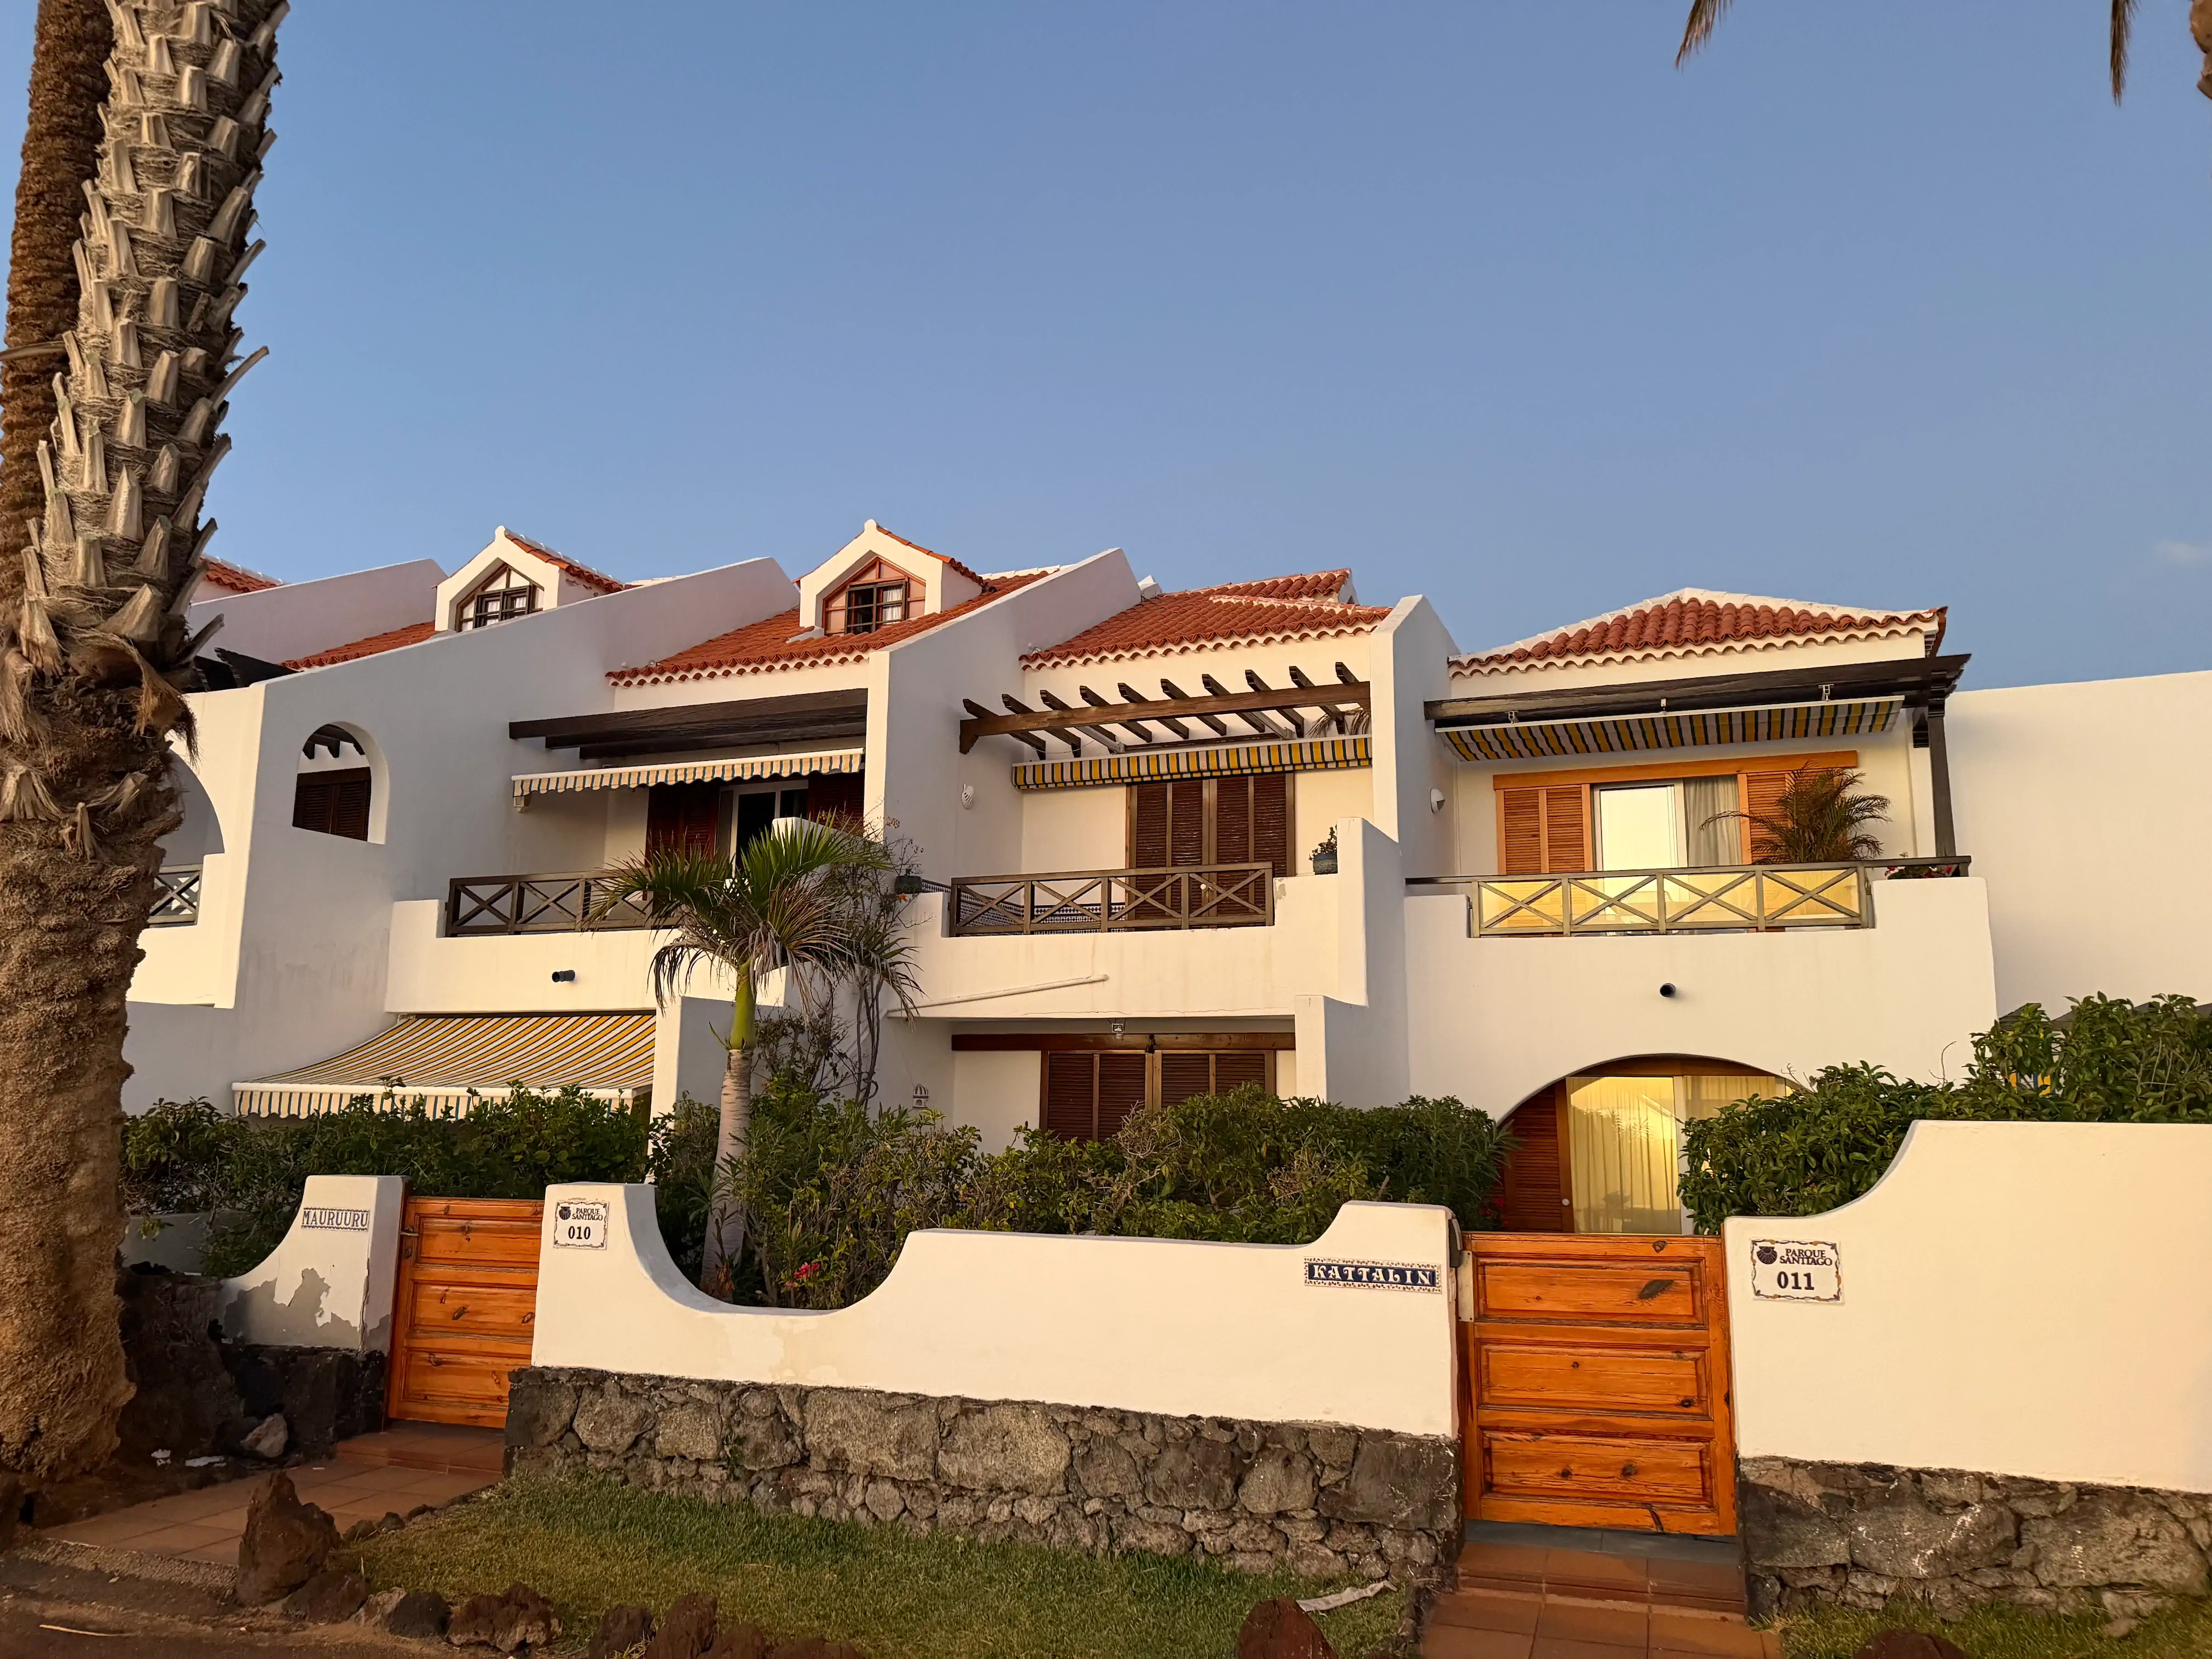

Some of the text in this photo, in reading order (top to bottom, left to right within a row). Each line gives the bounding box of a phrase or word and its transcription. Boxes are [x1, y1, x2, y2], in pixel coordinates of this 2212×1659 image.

[302, 1211, 369, 1227] MAURUURU
[568, 1226, 591, 1240] 010
[1785, 1248, 1826, 1258] PARQUE
[1780, 1256, 1833, 1266] SANTIAGO
[1313, 1264, 1432, 1285] KATTALIN
[1777, 1271, 1815, 1291] 011
